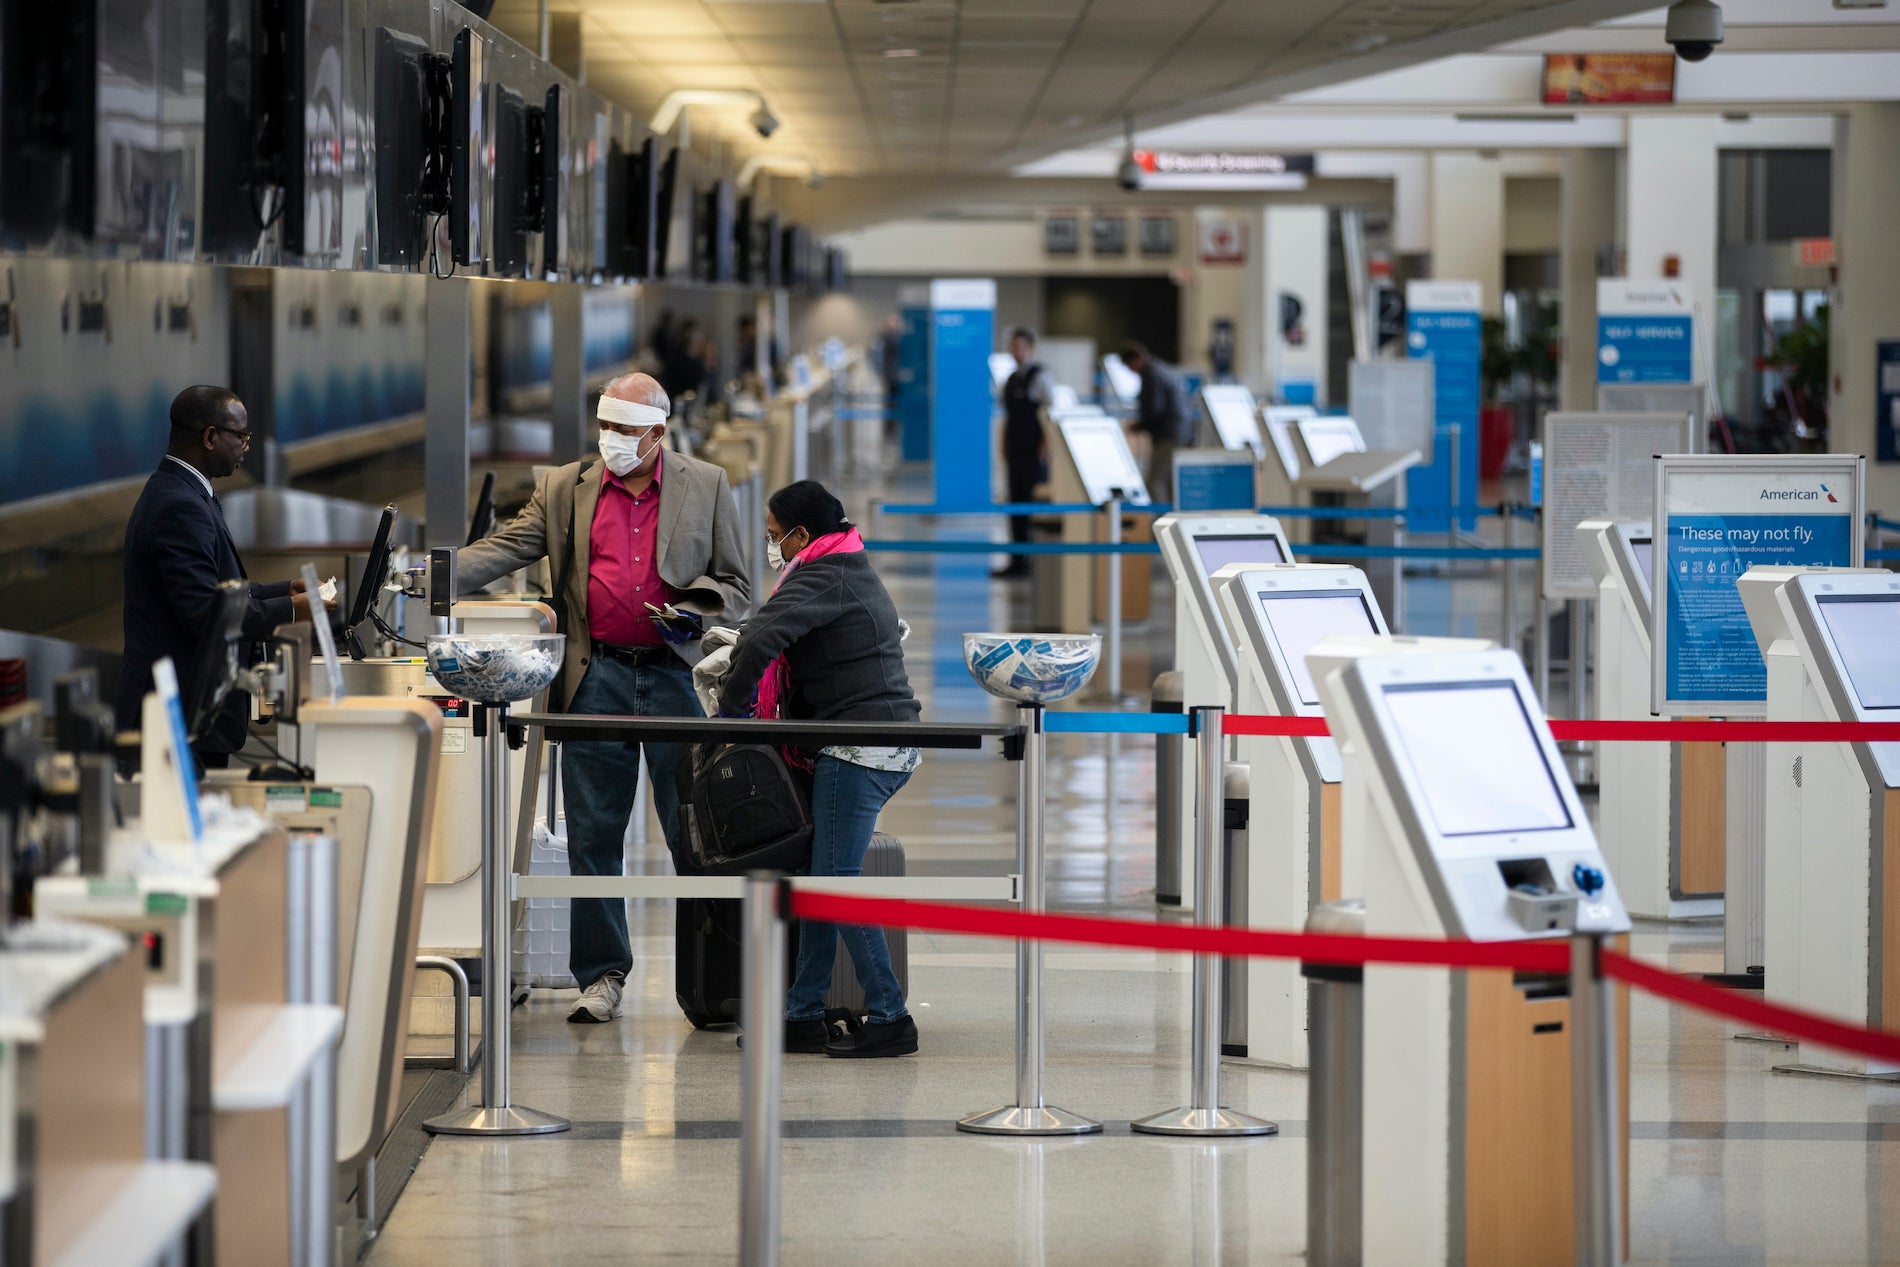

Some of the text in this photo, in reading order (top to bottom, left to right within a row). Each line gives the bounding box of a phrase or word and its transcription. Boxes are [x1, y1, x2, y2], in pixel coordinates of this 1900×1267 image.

[1760, 488, 1819, 500] American
[1680, 526, 1814, 544] These may not fly.
[1678, 546, 1712, 554] Dangerous
